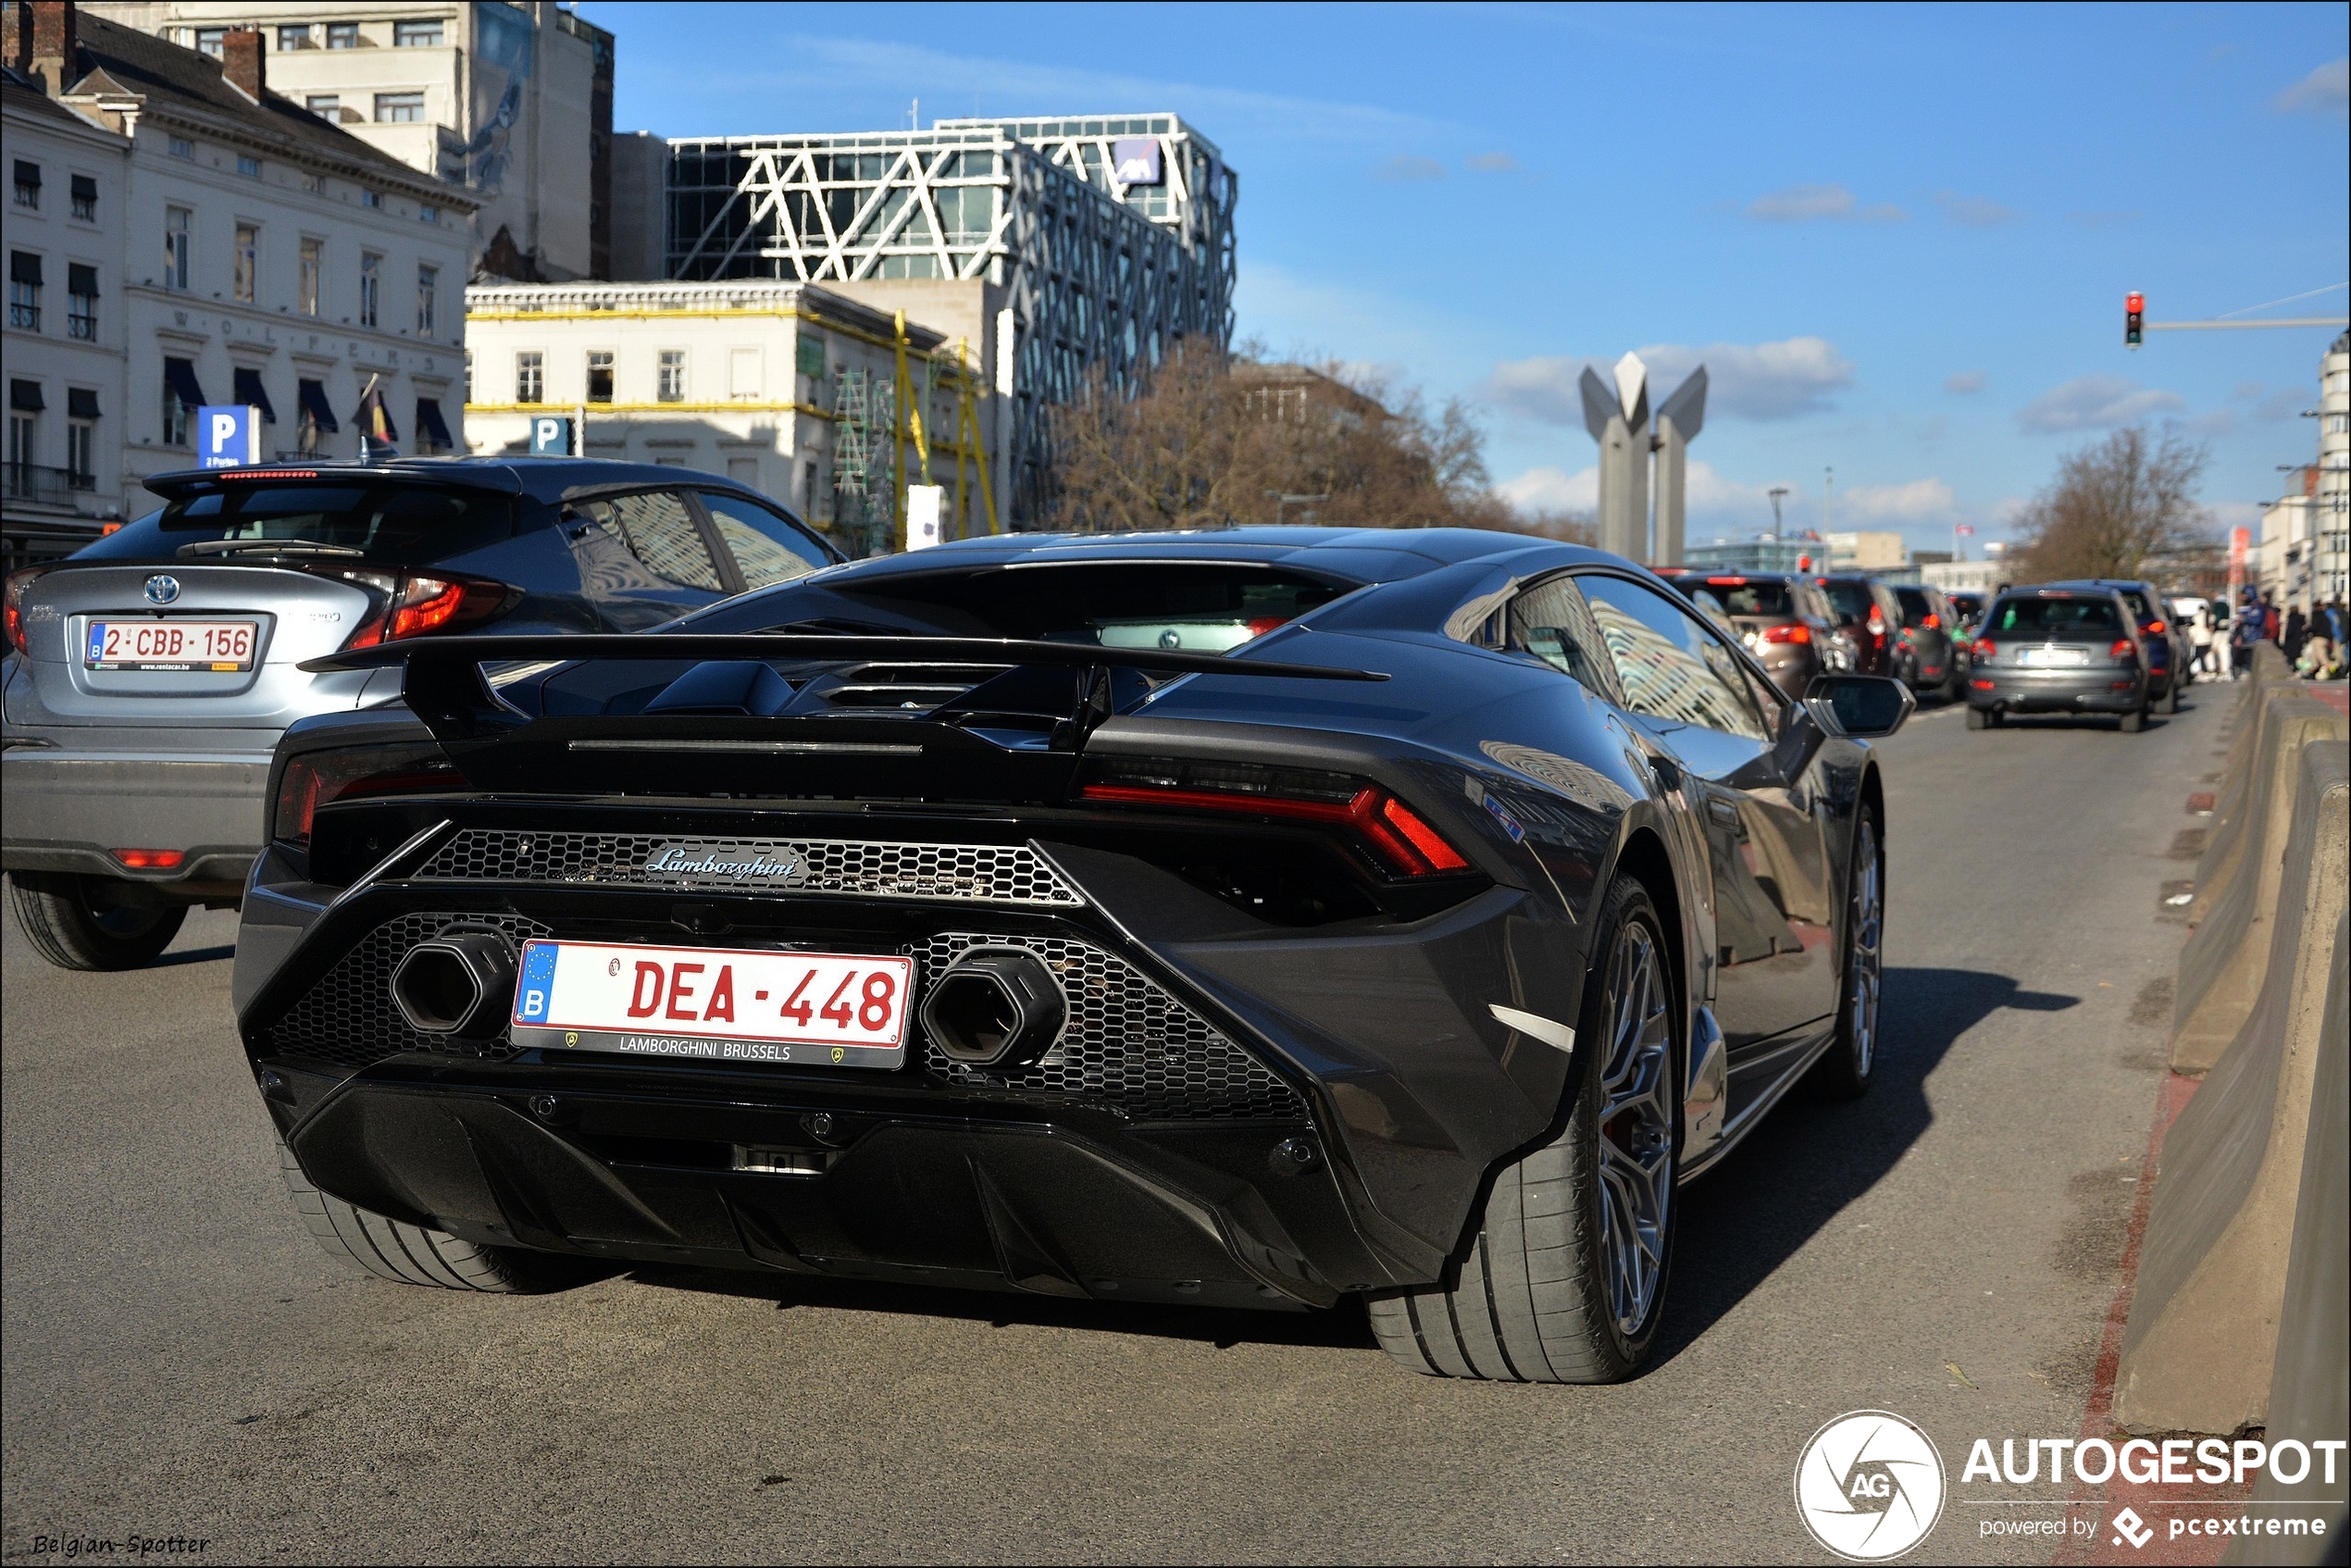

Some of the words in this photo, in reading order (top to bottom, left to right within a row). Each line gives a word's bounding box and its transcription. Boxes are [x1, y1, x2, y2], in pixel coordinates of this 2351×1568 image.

[212, 414, 236, 454] P
[537, 418, 559, 451] P
[92, 645, 101, 657] B
[646, 849, 799, 880] Lamborghini
[524, 989, 544, 1016] B
[619, 1036, 717, 1057] LAMBORGHINI
[723, 1044, 790, 1061] BRUSSELS
